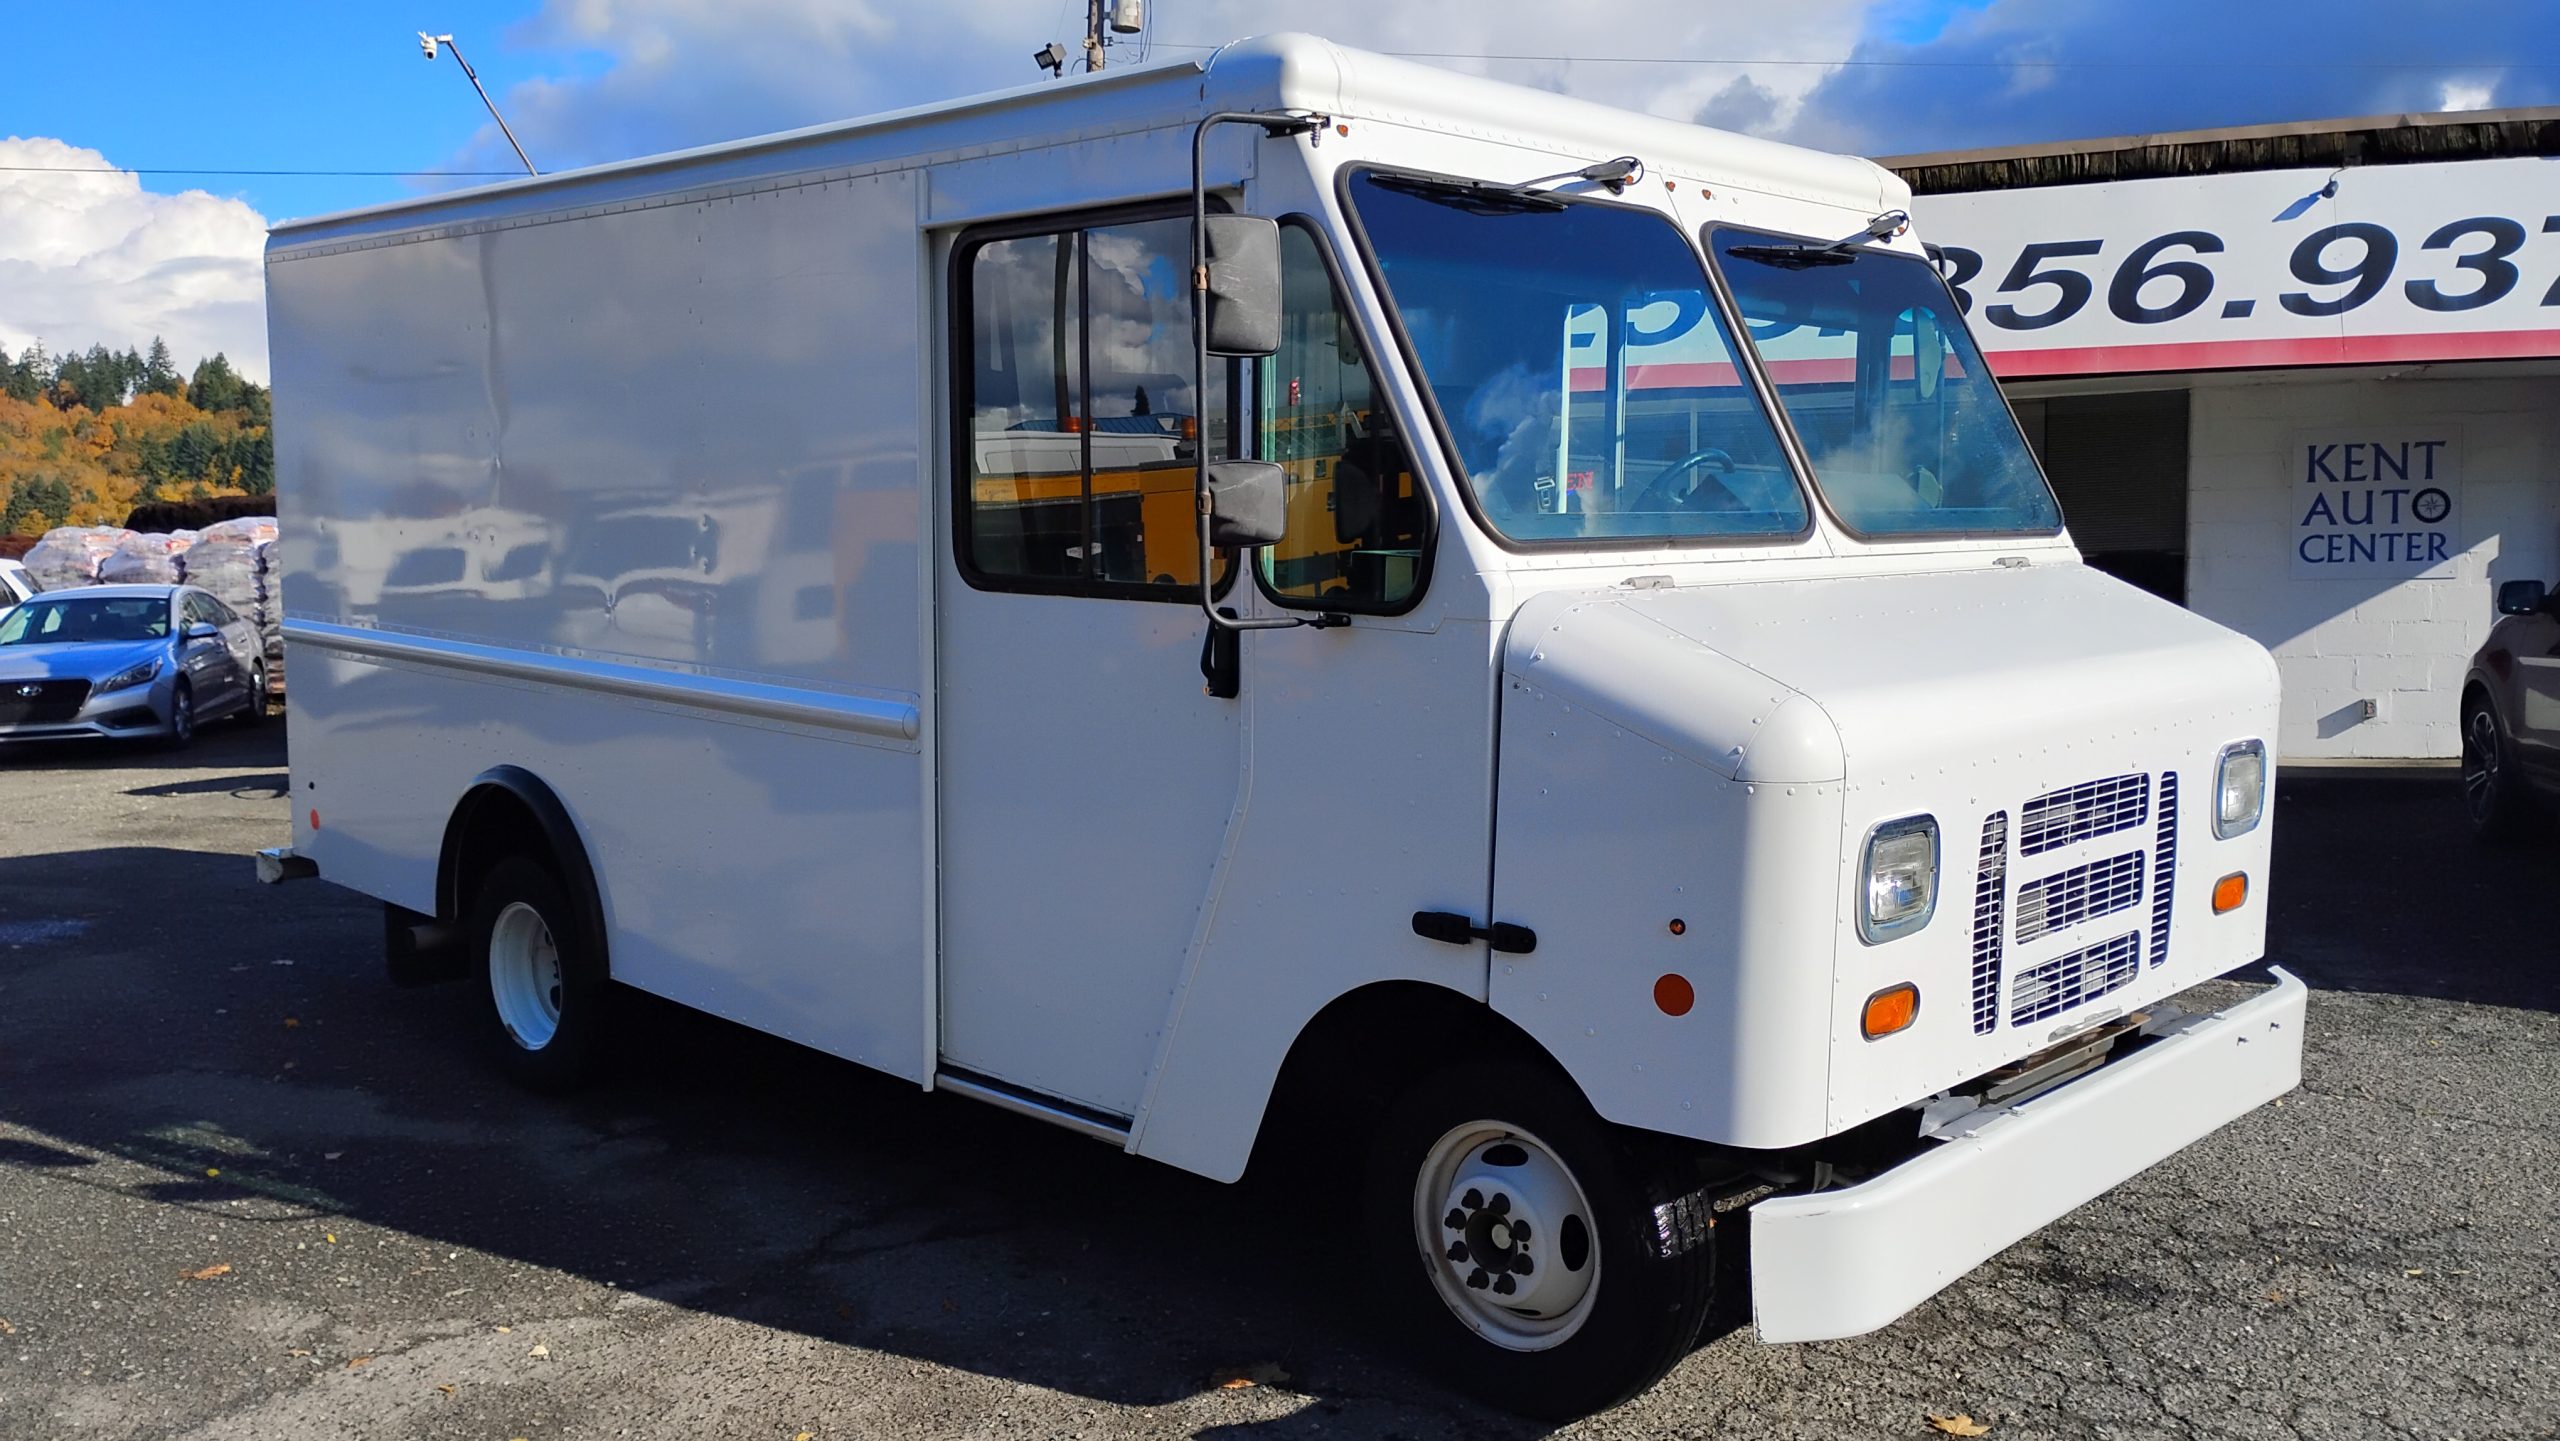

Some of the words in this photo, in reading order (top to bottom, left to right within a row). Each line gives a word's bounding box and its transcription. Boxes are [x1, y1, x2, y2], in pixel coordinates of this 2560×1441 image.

[2306, 440, 2447, 483] KENT
[2300, 487, 2452, 526] AUTO
[2299, 532, 2449, 563] CENTER
